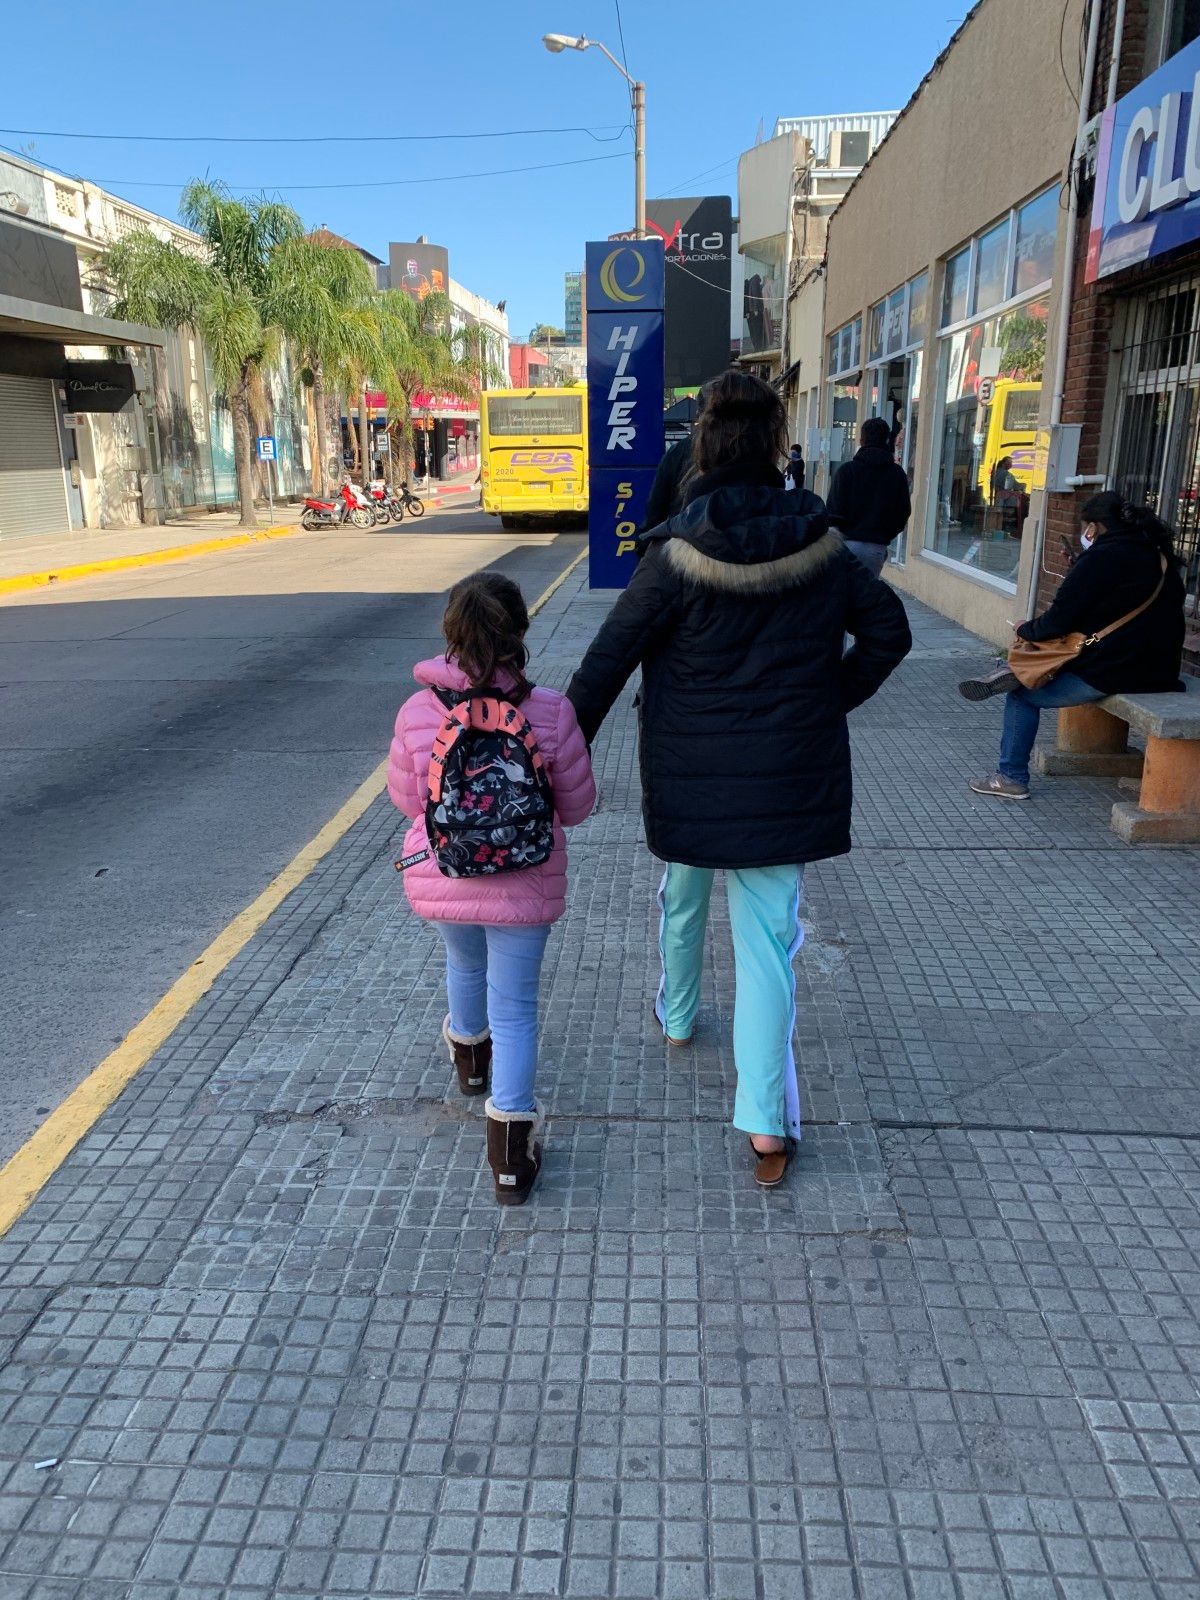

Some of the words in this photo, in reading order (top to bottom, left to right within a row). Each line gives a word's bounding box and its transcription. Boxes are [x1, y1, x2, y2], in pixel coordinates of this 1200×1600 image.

[645, 218, 724, 252] Xtra
[607, 326, 638, 450] HIPER
[262, 441, 271, 452] E
[495, 468, 515, 476] 2020
[414, 851, 426, 860] JUST
